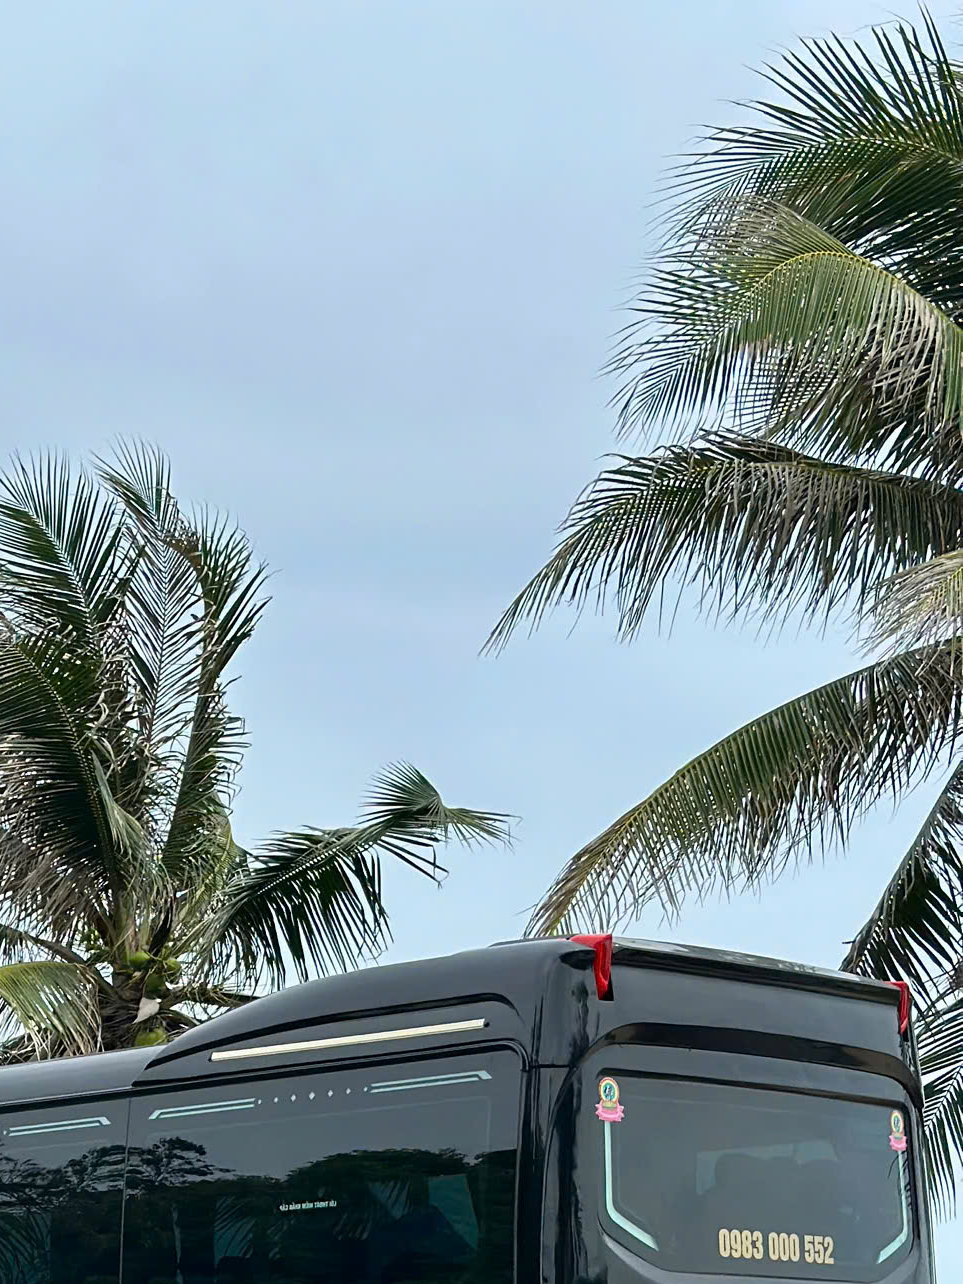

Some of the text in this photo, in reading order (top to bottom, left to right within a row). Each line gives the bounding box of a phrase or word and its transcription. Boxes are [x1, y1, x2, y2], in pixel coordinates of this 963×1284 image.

[718, 1228, 835, 1265] 0983 000 552
